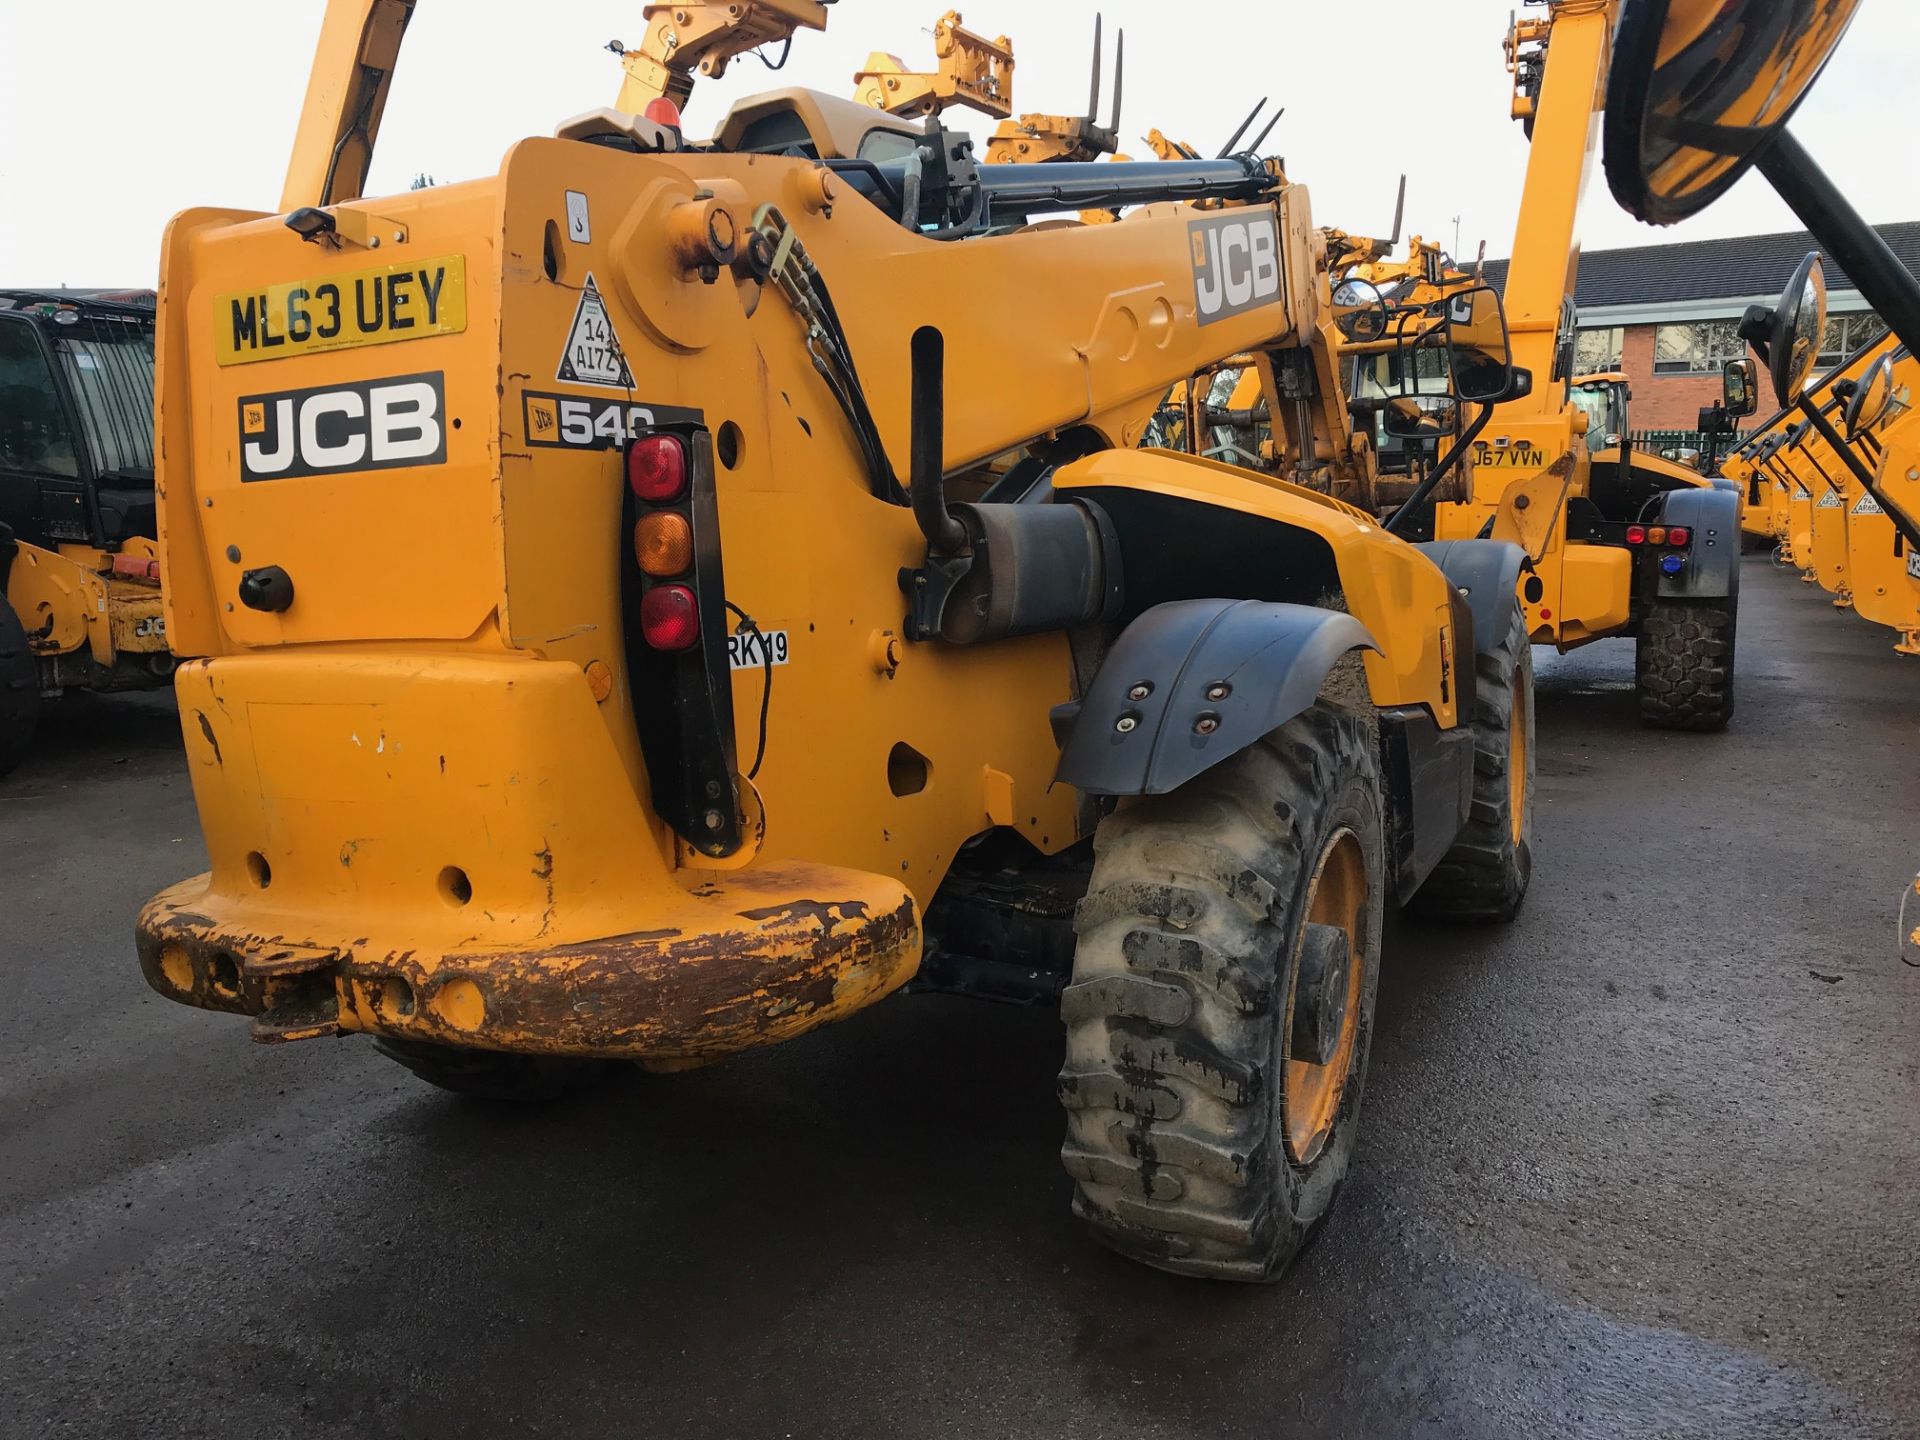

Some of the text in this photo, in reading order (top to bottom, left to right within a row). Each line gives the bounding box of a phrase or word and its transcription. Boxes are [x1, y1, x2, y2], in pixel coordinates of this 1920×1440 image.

[1197, 220, 1278, 315] JCB
[232, 267, 445, 351] ML63 UEY
[584, 318, 606, 342] 14
[245, 382, 440, 474] JCB
[1474, 451, 1542, 466] J67 VVN
[137, 618, 165, 636] JC
